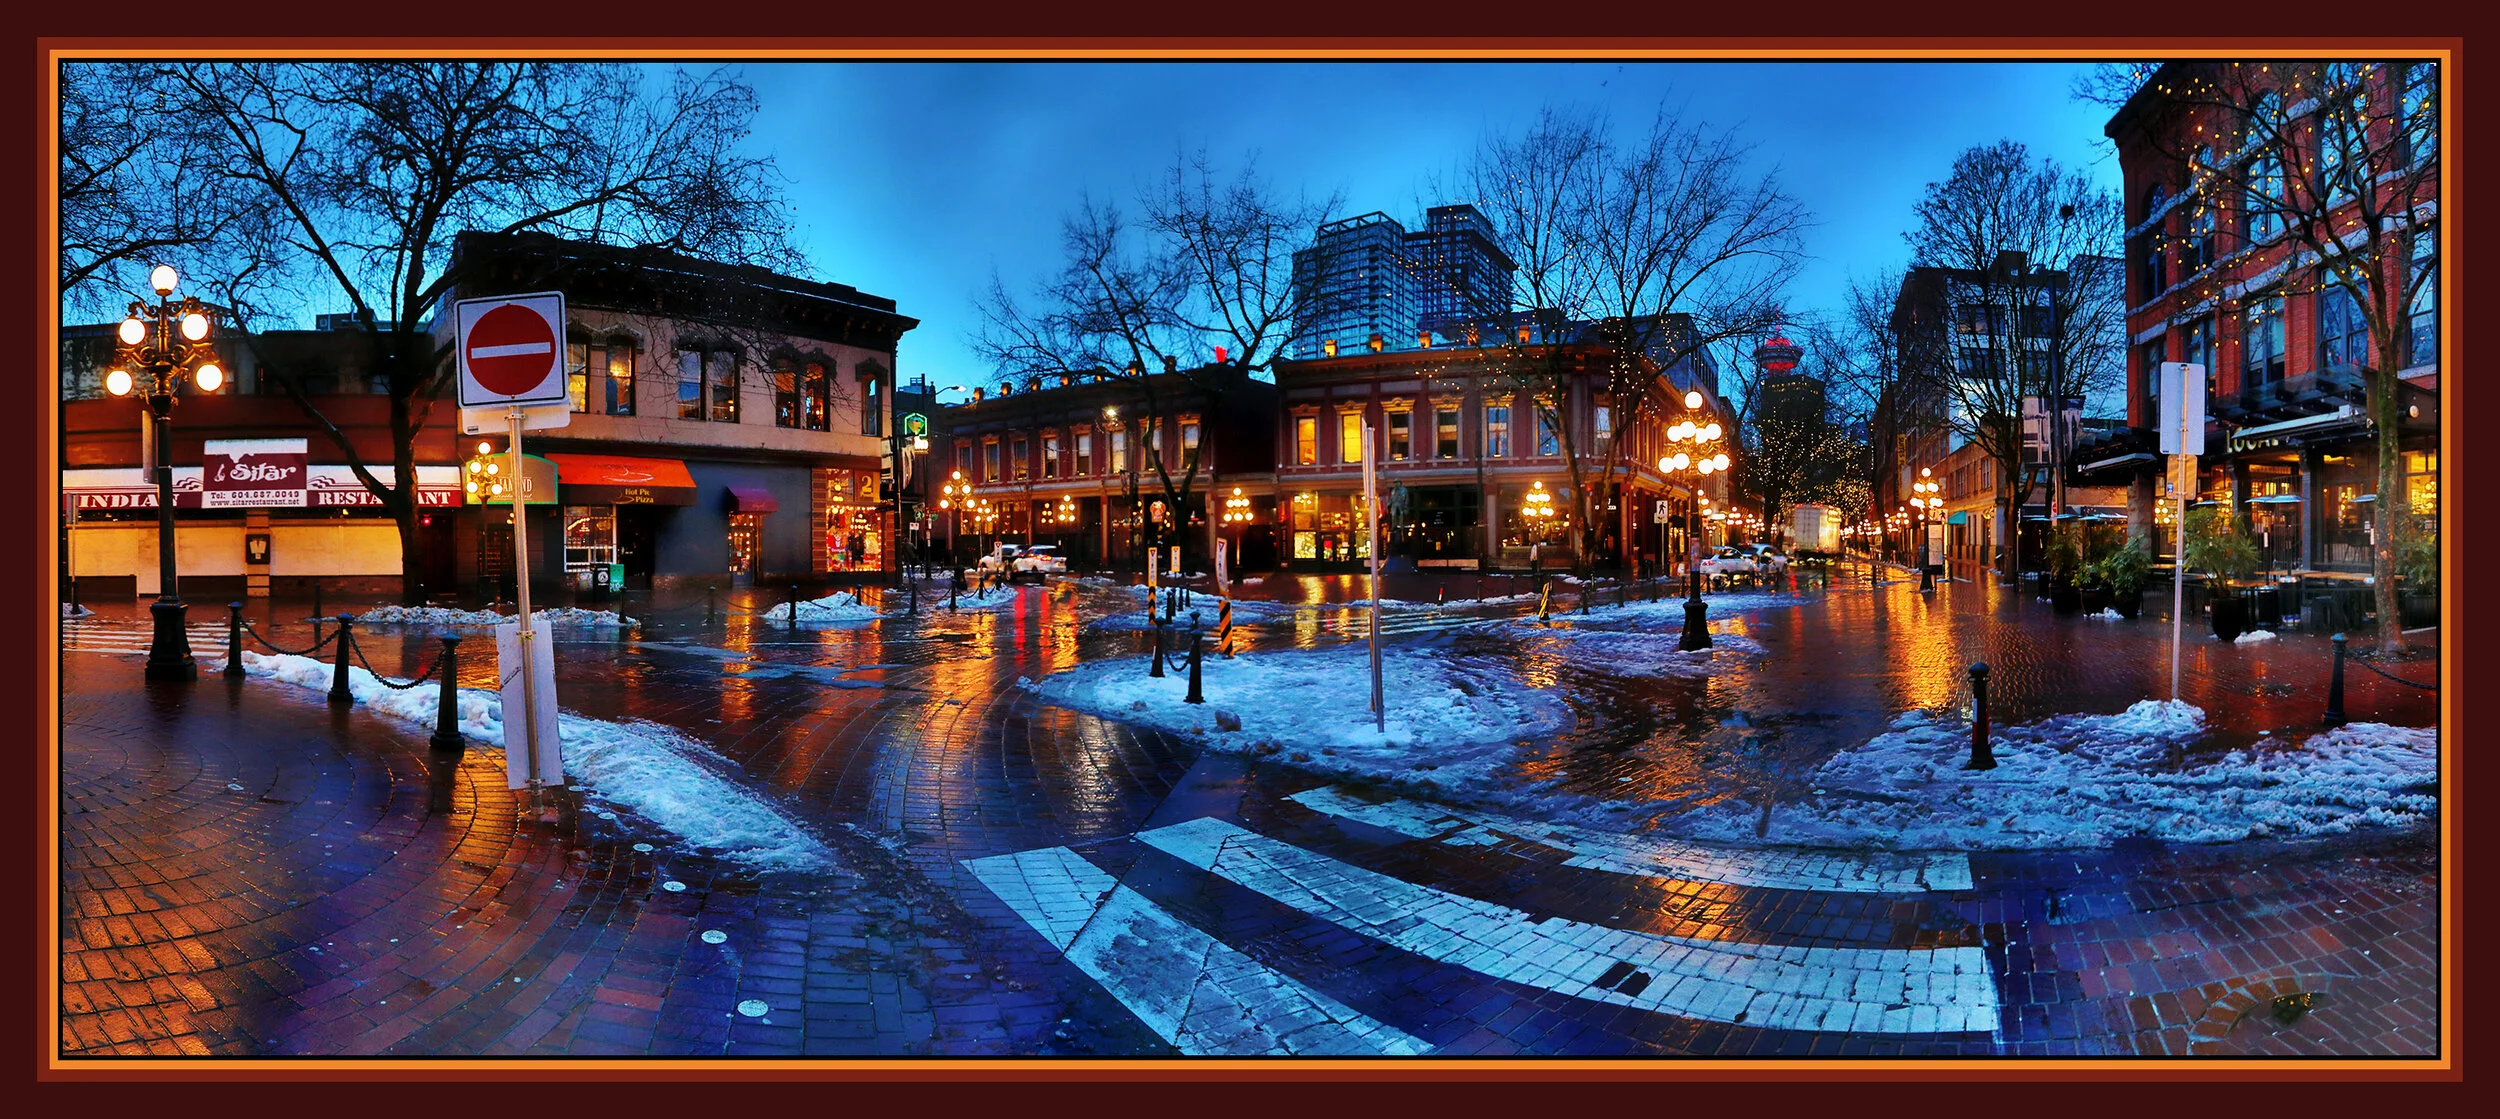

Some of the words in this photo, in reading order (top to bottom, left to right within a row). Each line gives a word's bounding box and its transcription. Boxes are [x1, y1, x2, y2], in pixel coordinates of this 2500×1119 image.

[2226, 426, 2279, 453] LOCA
[229, 463, 296, 482] Sitar
[318, 491, 451, 506] RESTAANT
[625, 488, 638, 496] Hot
[635, 496, 654, 504] Pizza
